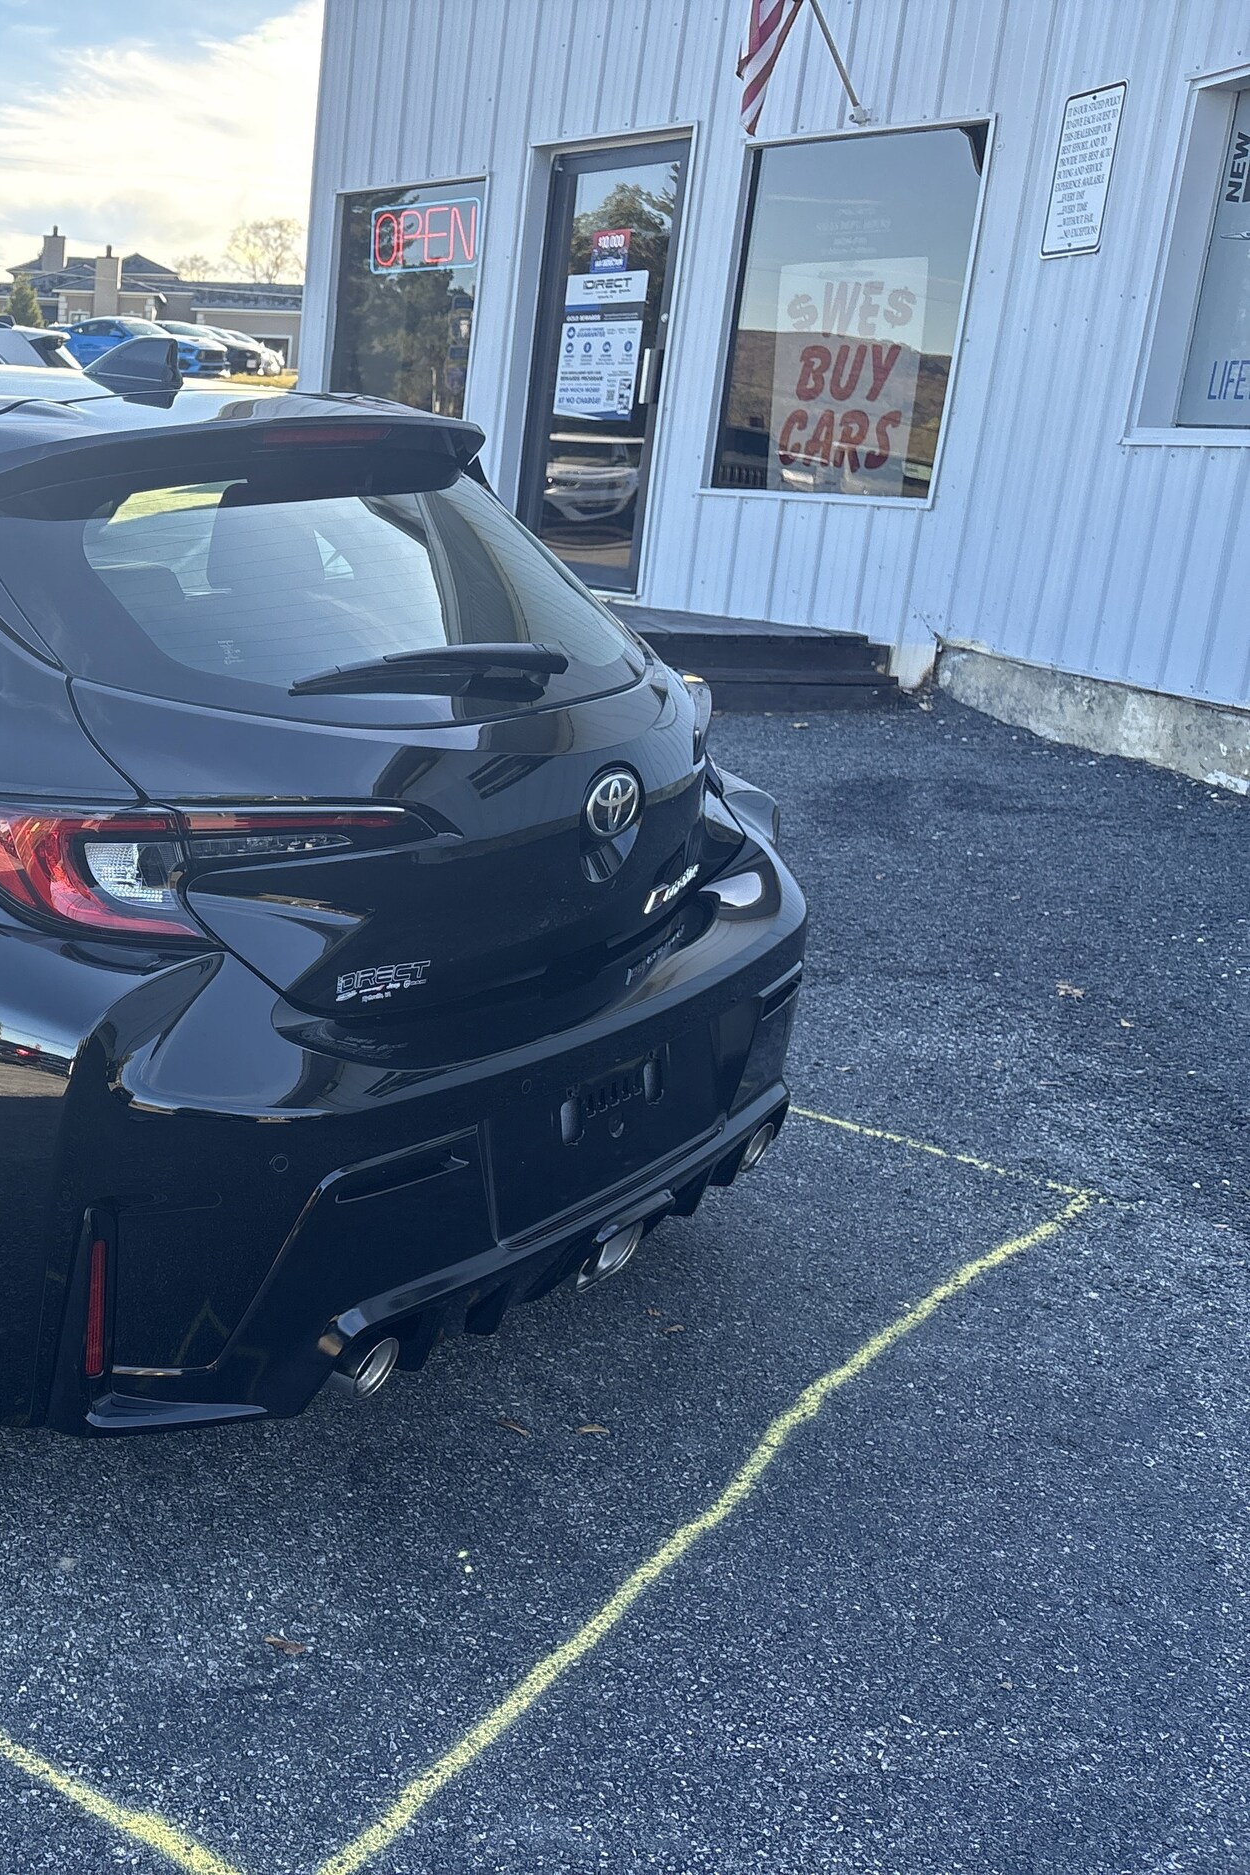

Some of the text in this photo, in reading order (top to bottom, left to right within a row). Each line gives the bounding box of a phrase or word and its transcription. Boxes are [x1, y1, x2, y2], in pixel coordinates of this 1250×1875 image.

[1225, 131, 1250, 203] NEW
[374, 206, 476, 267] OPEN
[795, 344, 902, 402] BUY
[1207, 360, 1250, 400] LIFE
[778, 408, 902, 473] CARS
[342, 960, 431, 993] DIRECT
